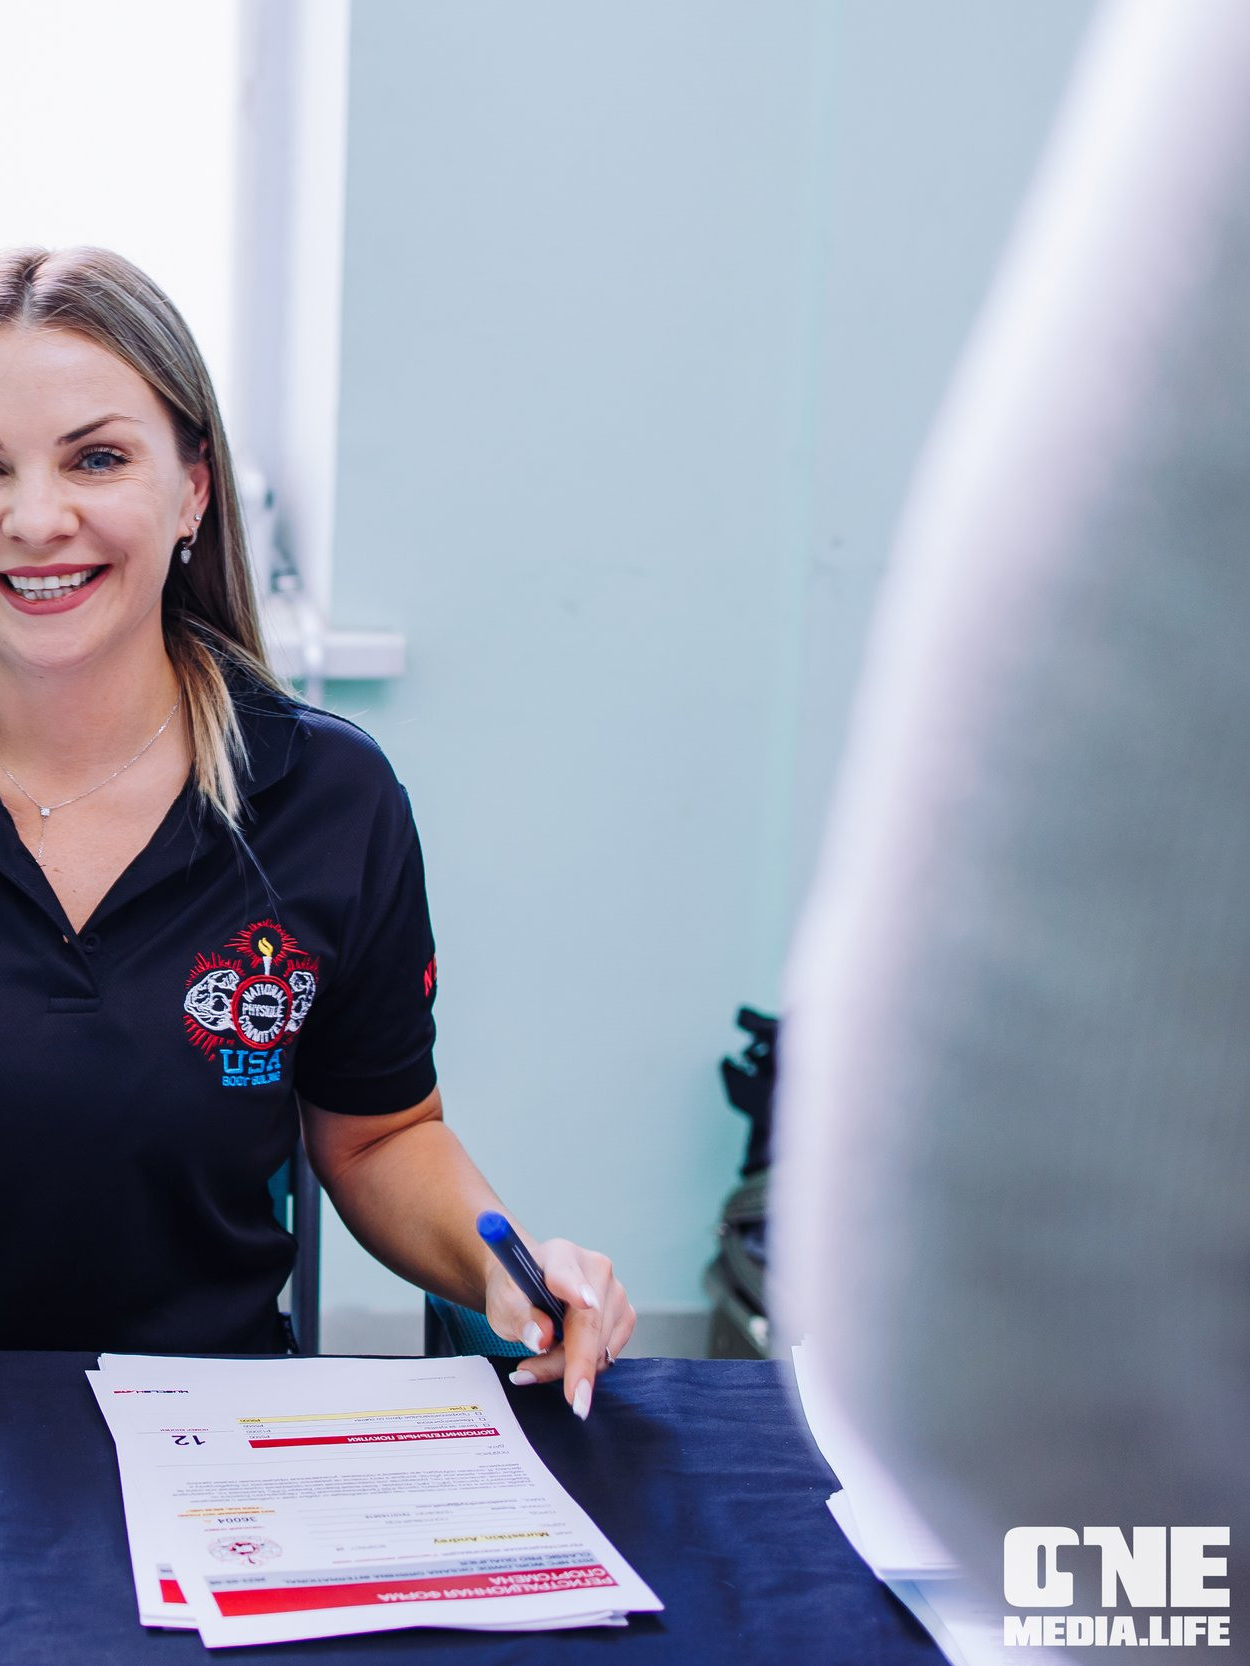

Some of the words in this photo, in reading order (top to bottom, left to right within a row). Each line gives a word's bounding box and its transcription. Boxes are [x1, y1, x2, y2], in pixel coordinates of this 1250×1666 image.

[242, 983, 288, 1004] NATIONAL
[219, 1048, 284, 1074] USA
[171, 1435, 206, 1446] 12
[396, 1429, 495, 1440] ДОПОЛНИТЕЛЬНЫЕ
[216, 1516, 257, 1524] 36004
[433, 1537, 478, 1545] Andrey
[488, 1568, 608, 1586] СПОРТСМЕНА
[443, 1577, 615, 1599] РЕГИСТРАЦИОННАЯ
[376, 1589, 442, 1602] ФОРМА
